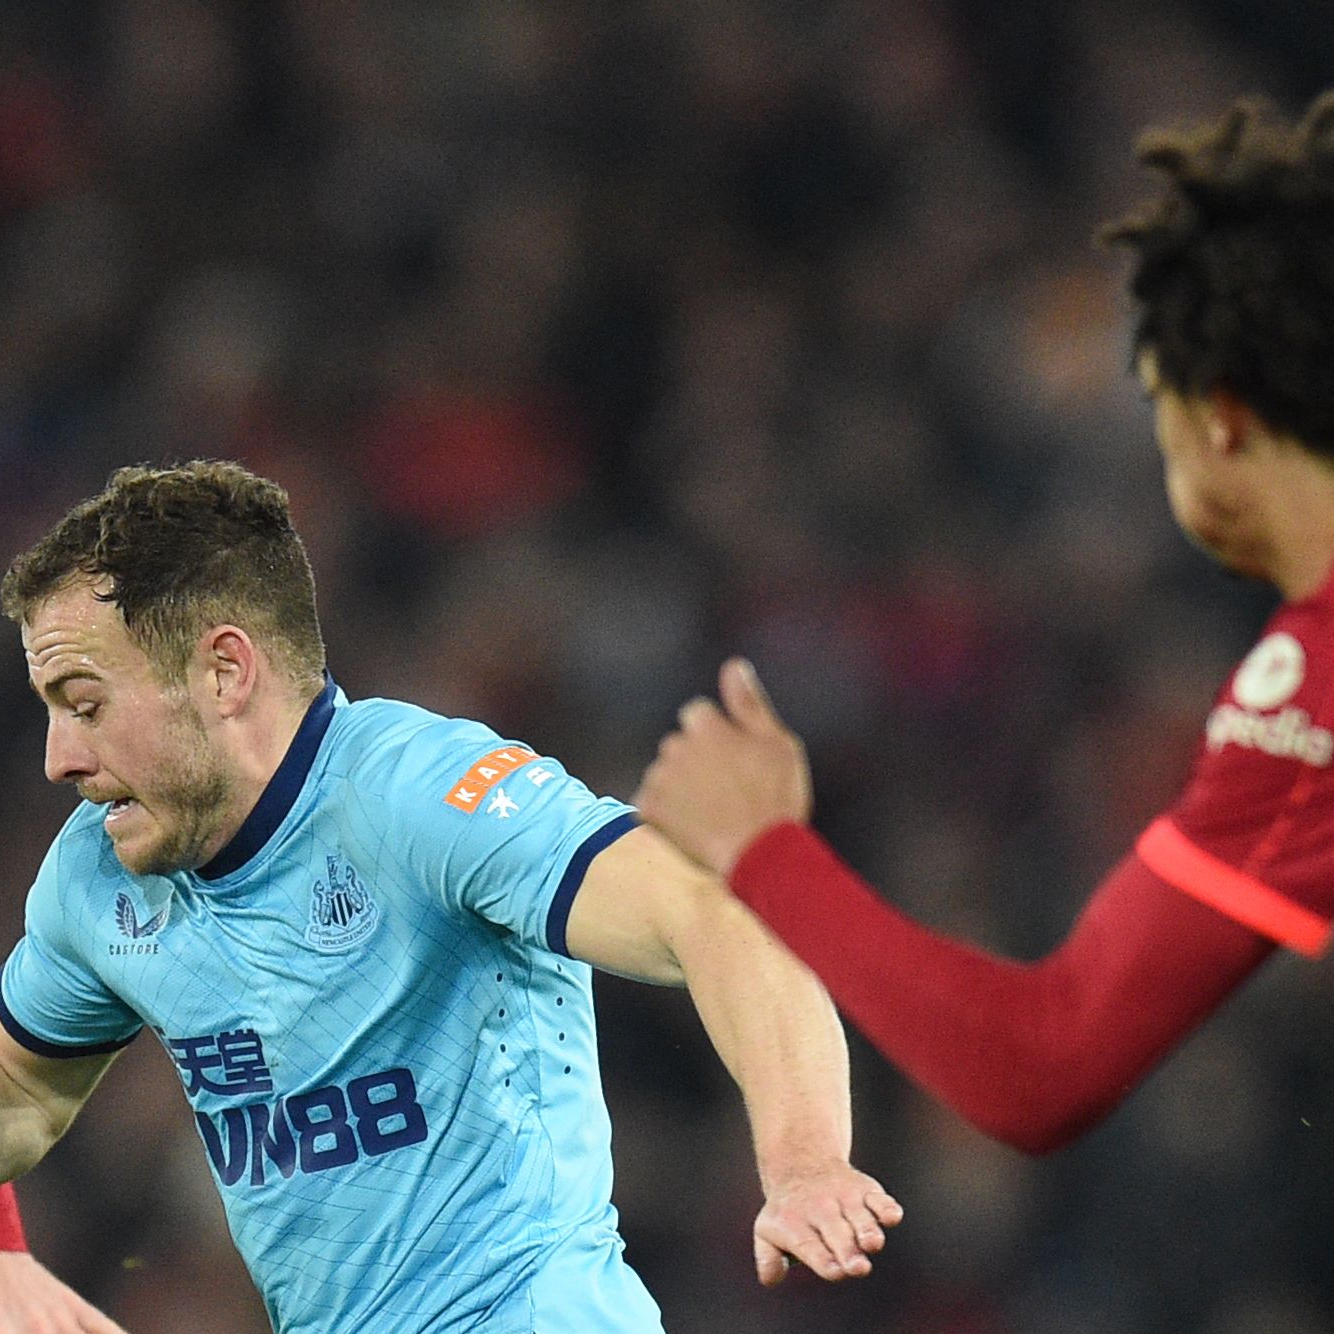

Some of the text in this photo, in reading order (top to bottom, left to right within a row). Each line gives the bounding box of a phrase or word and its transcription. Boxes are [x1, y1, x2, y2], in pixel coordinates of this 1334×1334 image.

[454, 748, 528, 803] KAY
[109, 943, 159, 956] CASTORE
[165, 1028, 273, 1097] 天堂
[194, 1067, 428, 1187] UN88
